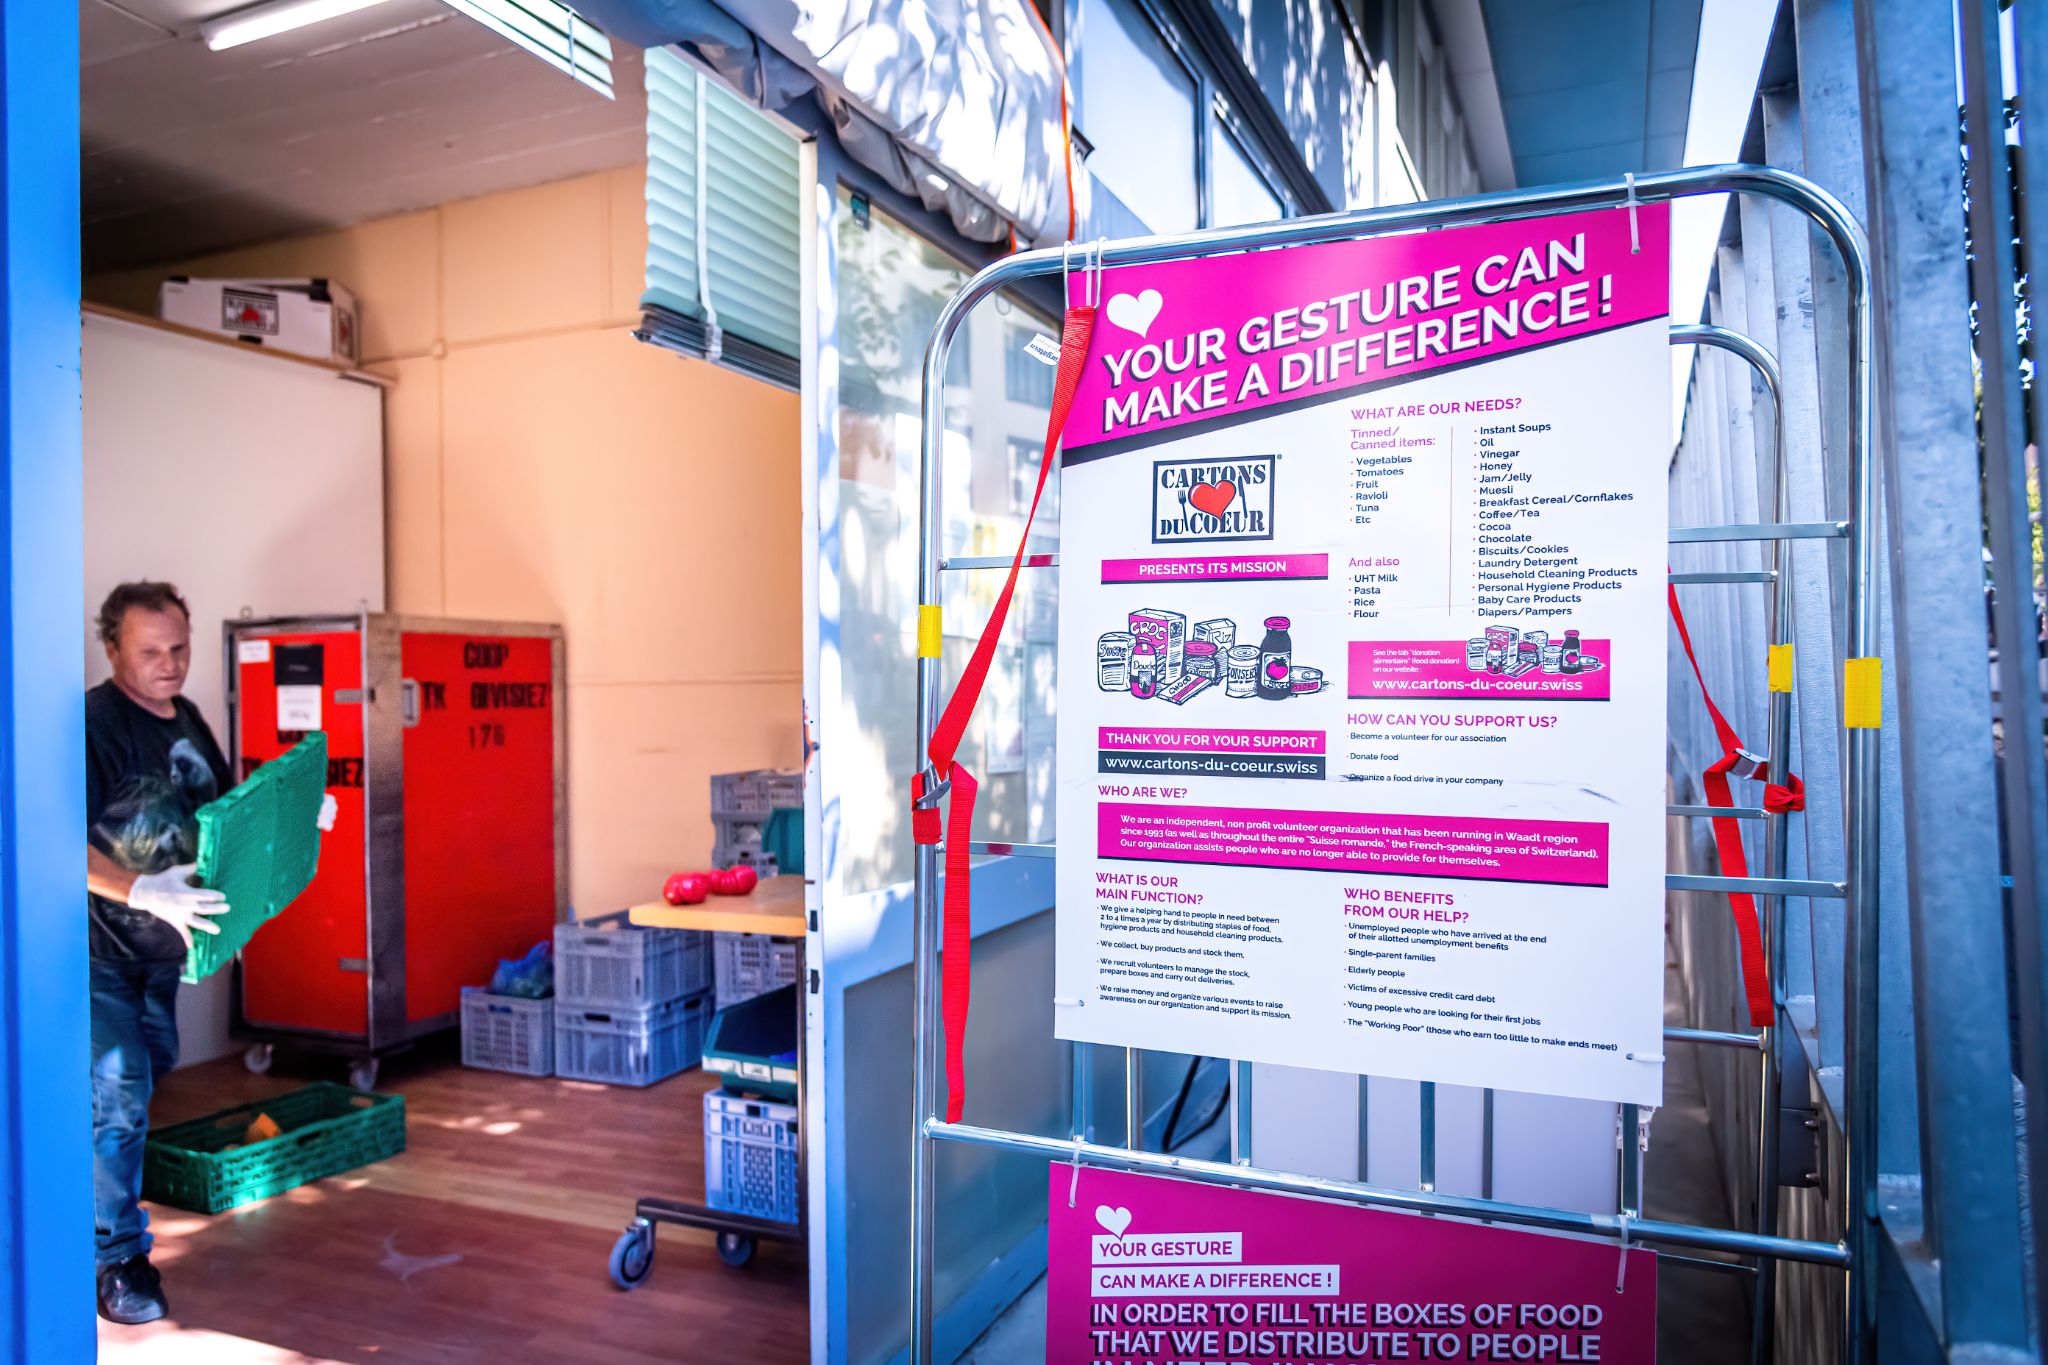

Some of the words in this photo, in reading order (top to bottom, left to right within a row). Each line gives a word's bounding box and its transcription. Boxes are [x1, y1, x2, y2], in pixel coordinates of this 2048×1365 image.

[1102, 327, 1227, 388] YOUR
[1237, 263, 1461, 355] GESTURE
[1473, 232, 1585, 296] CAN
[1102, 369, 1228, 433] MAKE
[1235, 362, 1270, 404] A
[1280, 280, 1590, 392] DIFFERENCE
[1599, 273, 1612, 317] !
[1351, 407, 1393, 419] WHAT
[1397, 404, 1424, 416] ARE
[1429, 402, 1459, 414] OUR
[1465, 397, 1521, 412] NEEDS?
[1350, 426, 1401, 438] Tinned/
[1480, 425, 1515, 434] Instant
[1518, 424, 1550, 432] Soups
[1350, 438, 1395, 449] Canned
[1399, 438, 1436, 446] items:
[1480, 438, 1493, 446] Oil
[1356, 455, 1412, 466] Vegetables
[1480, 450, 1519, 459] Vinegar
[1355, 468, 1403, 476] Tomatoes
[1480, 462, 1512, 471] Honey
[1161, 464, 1266, 489] CARTONS
[1479, 472, 1531, 482] Jam/Jelly
[1356, 480, 1378, 488] Fruit
[1479, 485, 1512, 494] Muesli
[1356, 491, 1387, 499] Ravioli
[1479, 497, 1528, 506] Breakfast
[1532, 492, 1632, 504] Cereal/Cornflakes
[1479, 509, 1539, 518] Coffee/Tea
[1160, 518, 1184, 535] DU
[1190, 510, 1265, 534] COEUR
[1478, 534, 1531, 543] Chocolate
[1478, 544, 1568, 555] Biscuits/Cookies
[1348, 557, 1371, 566] And
[1375, 556, 1399, 566] also
[1478, 558, 1520, 568] Laundry
[1524, 557, 1577, 567] Detergent
[1139, 563, 1203, 574] PRESENTS
[1208, 563, 1227, 573] ITS
[1231, 561, 1286, 572] MISSION
[1478, 570, 1534, 579] Household
[1538, 569, 1584, 579] Cleaning
[1588, 568, 1637, 576] Products
[1354, 574, 1375, 582] UHT
[1354, 586, 1380, 594] Pasta
[1478, 582, 1523, 591] Personal
[1526, 582, 1569, 592] Hygiene
[1573, 580, 1621, 589] Products
[1478, 596, 1503, 605] Baby
[1506, 595, 1530, 603] Care
[1534, 594, 1581, 602] Products
[1478, 607, 1571, 617] Diapers/Pampers
[1372, 678, 1583, 691] www.cartons-du-coeur.swiss
[1348, 714, 1382, 724] HOW
[1386, 714, 1415, 724] CAN
[1420, 714, 1449, 725] YOU
[1454, 715, 1524, 726] SUPPORT
[1528, 716, 1556, 727] US?
[1106, 733, 1150, 743] THANK
[1153, 734, 1180, 744] YOU
[1184, 734, 1209, 745] FOR
[1212, 735, 1249, 746] YOUR
[1253, 736, 1317, 747] SUPPORT
[1105, 757, 1317, 773] www.cartons-du-coeur.swiss
[1098, 785, 1129, 795] WHO
[1132, 786, 1156, 797] ARE
[1159, 787, 1186, 797] WE?
[1120, 815, 1135, 824] We
[1166, 816, 1225, 828] independent,
[1227, 821, 1244, 832] non
[1247, 820, 1271, 830] profit
[1272, 822, 1318, 831] volunteer
[1319, 825, 1379, 834] organization
[1381, 826, 1401, 835] that
[1404, 827, 1421, 836] has
[1424, 828, 1449, 836] been
[1452, 831, 1491, 841] running
[1494, 831, 1503, 839] in
[1505, 832, 1540, 841] Waadt
[1543, 835, 1577, 844] region
[1095, 872, 1134, 885] WHAT
[1136, 875, 1147, 885] IS
[1150, 876, 1177, 887] OUR
[1096, 888, 1128, 900] MAIN
[1131, 890, 1202, 904] FUNCTION?
[1344, 888, 1379, 900] WHO
[1384, 890, 1453, 905] BENEFITS
[1344, 904, 1383, 917] FROM
[1388, 907, 1418, 919] OUR
[1424, 909, 1468, 922] HELP?
[1140, 943, 1153, 951] buy
[1224, 950, 1244, 958] them.
[1348, 948, 1401, 958] Single-parent
[1404, 952, 1435, 961] families
[1348, 965, 1375, 975] Elderly
[1377, 969, 1404, 977] people
[1100, 1243, 1146, 1256] YOUR
[1151, 1241, 1232, 1255] GESTURE
[1100, 1275, 1134, 1288] CAN
[1141, 1273, 1189, 1287] MAKE
[1193, 1274, 1205, 1287] A
[1210, 1273, 1321, 1287] DIFFERENCE
[1327, 1272, 1330, 1286] !
[1092, 1303, 1118, 1325] IN
[1124, 1302, 1209, 1324] ORDER
[1213, 1303, 1249, 1325] TO
[1255, 1302, 1309, 1325] FILL
[1313, 1303, 1367, 1325] THE
[1374, 1303, 1466, 1326] BOXES
[1472, 1303, 1513, 1326] OF
[1519, 1304, 1603, 1327] FOOD
[1091, 1330, 1166, 1354] THAT
[1171, 1331, 1220, 1355] WE
[1227, 1331, 1409, 1356] DISTRIBUTE
[1415, 1332, 1461, 1358] TO
[1470, 1333, 1601, 1361] PEOPLE
